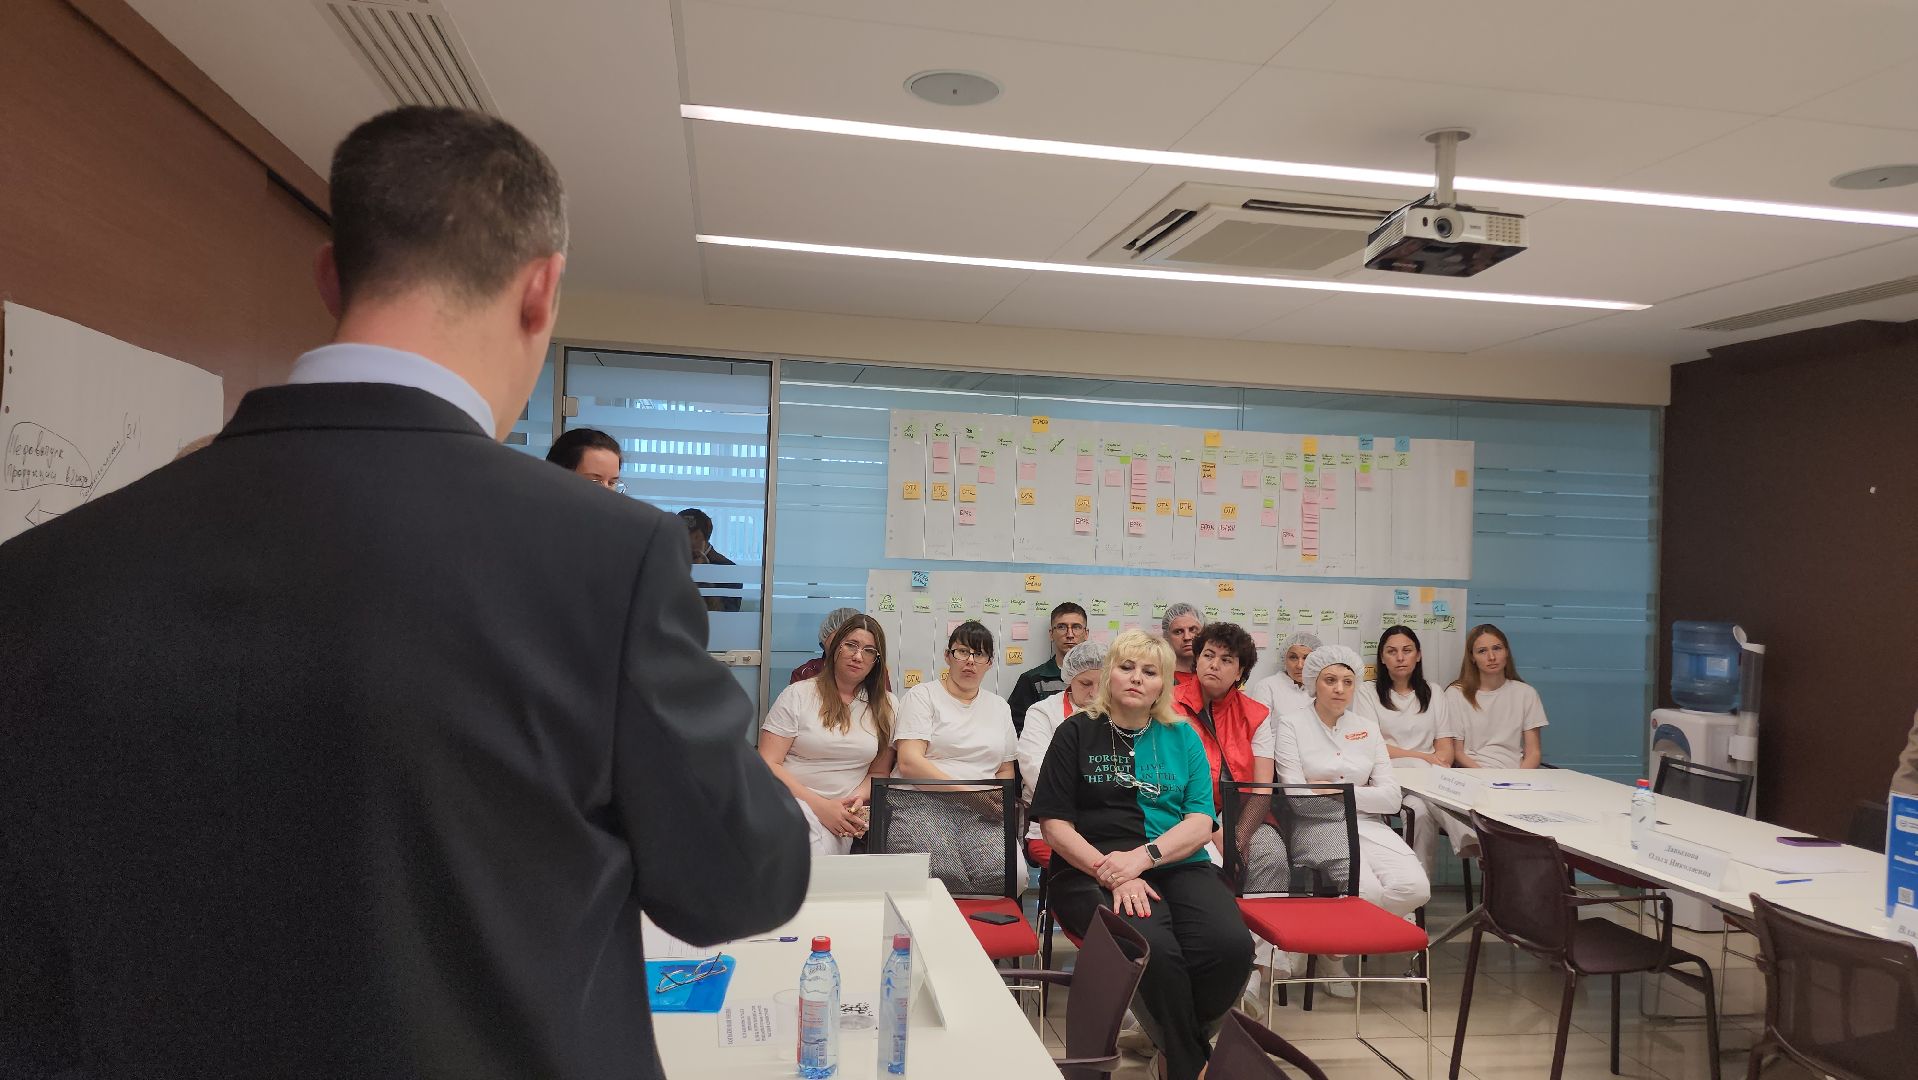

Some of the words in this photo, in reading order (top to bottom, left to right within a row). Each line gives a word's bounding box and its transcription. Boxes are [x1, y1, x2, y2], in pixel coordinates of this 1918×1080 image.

[1089, 755, 1130, 764] FORGET
[1094, 765, 1131, 773] ABOUT
[1083, 774, 1104, 783] THE
